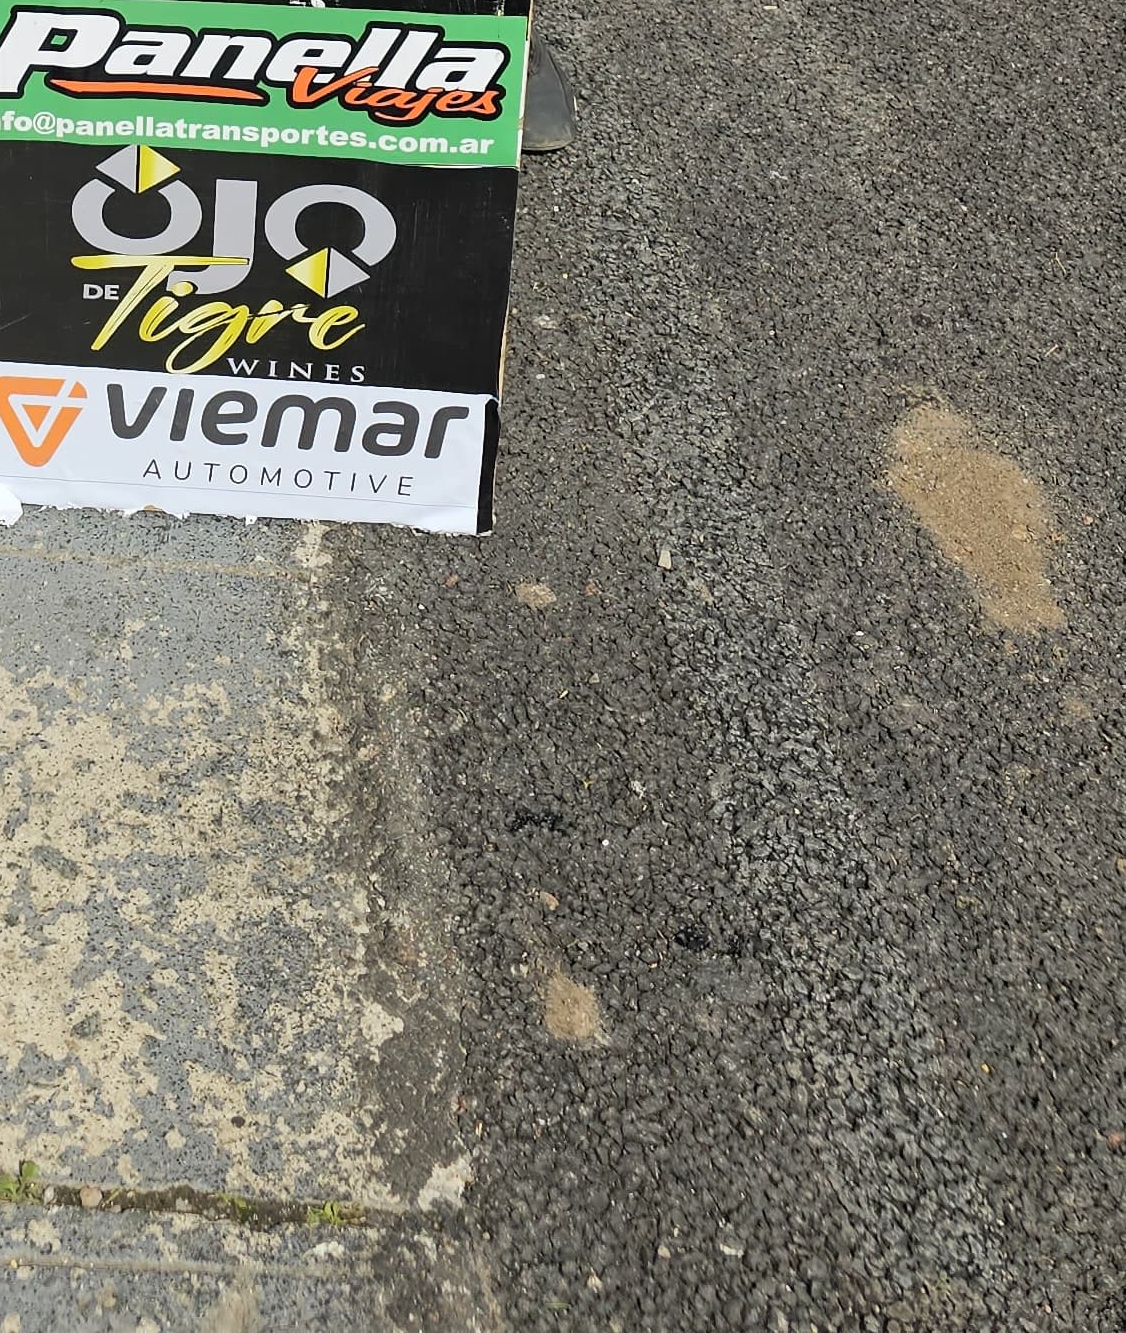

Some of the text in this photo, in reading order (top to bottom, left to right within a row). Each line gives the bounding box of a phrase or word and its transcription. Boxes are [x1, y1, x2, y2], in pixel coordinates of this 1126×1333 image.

[291, 65, 502, 121] Viajes
[72, 254, 365, 375] DE Tigre
[227, 357, 366, 382] WINES
[143, 458, 415, 497] AUTOMOTIVE
